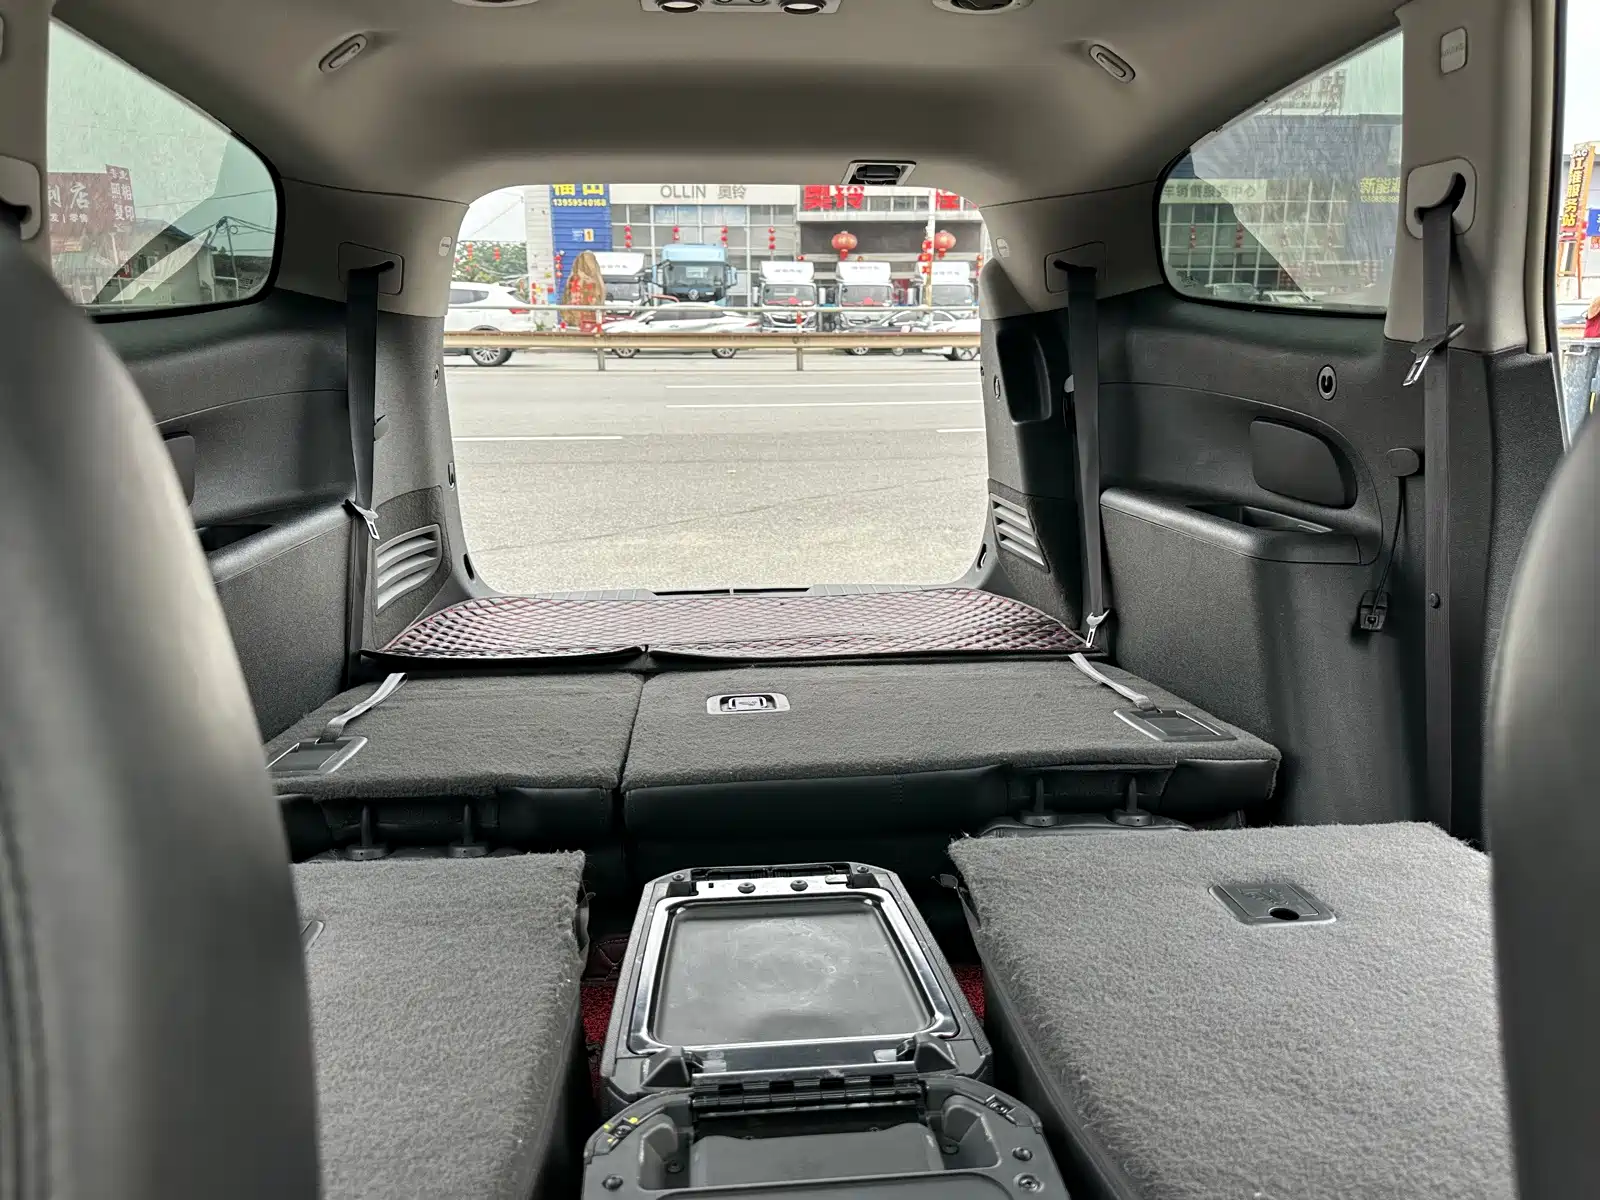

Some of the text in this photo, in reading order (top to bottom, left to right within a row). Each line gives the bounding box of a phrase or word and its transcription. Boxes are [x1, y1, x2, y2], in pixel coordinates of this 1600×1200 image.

[111, 183, 132, 200] 照相
[660, 185, 746, 199] OLLIN 奥铃
[114, 204, 135, 221] 复印
